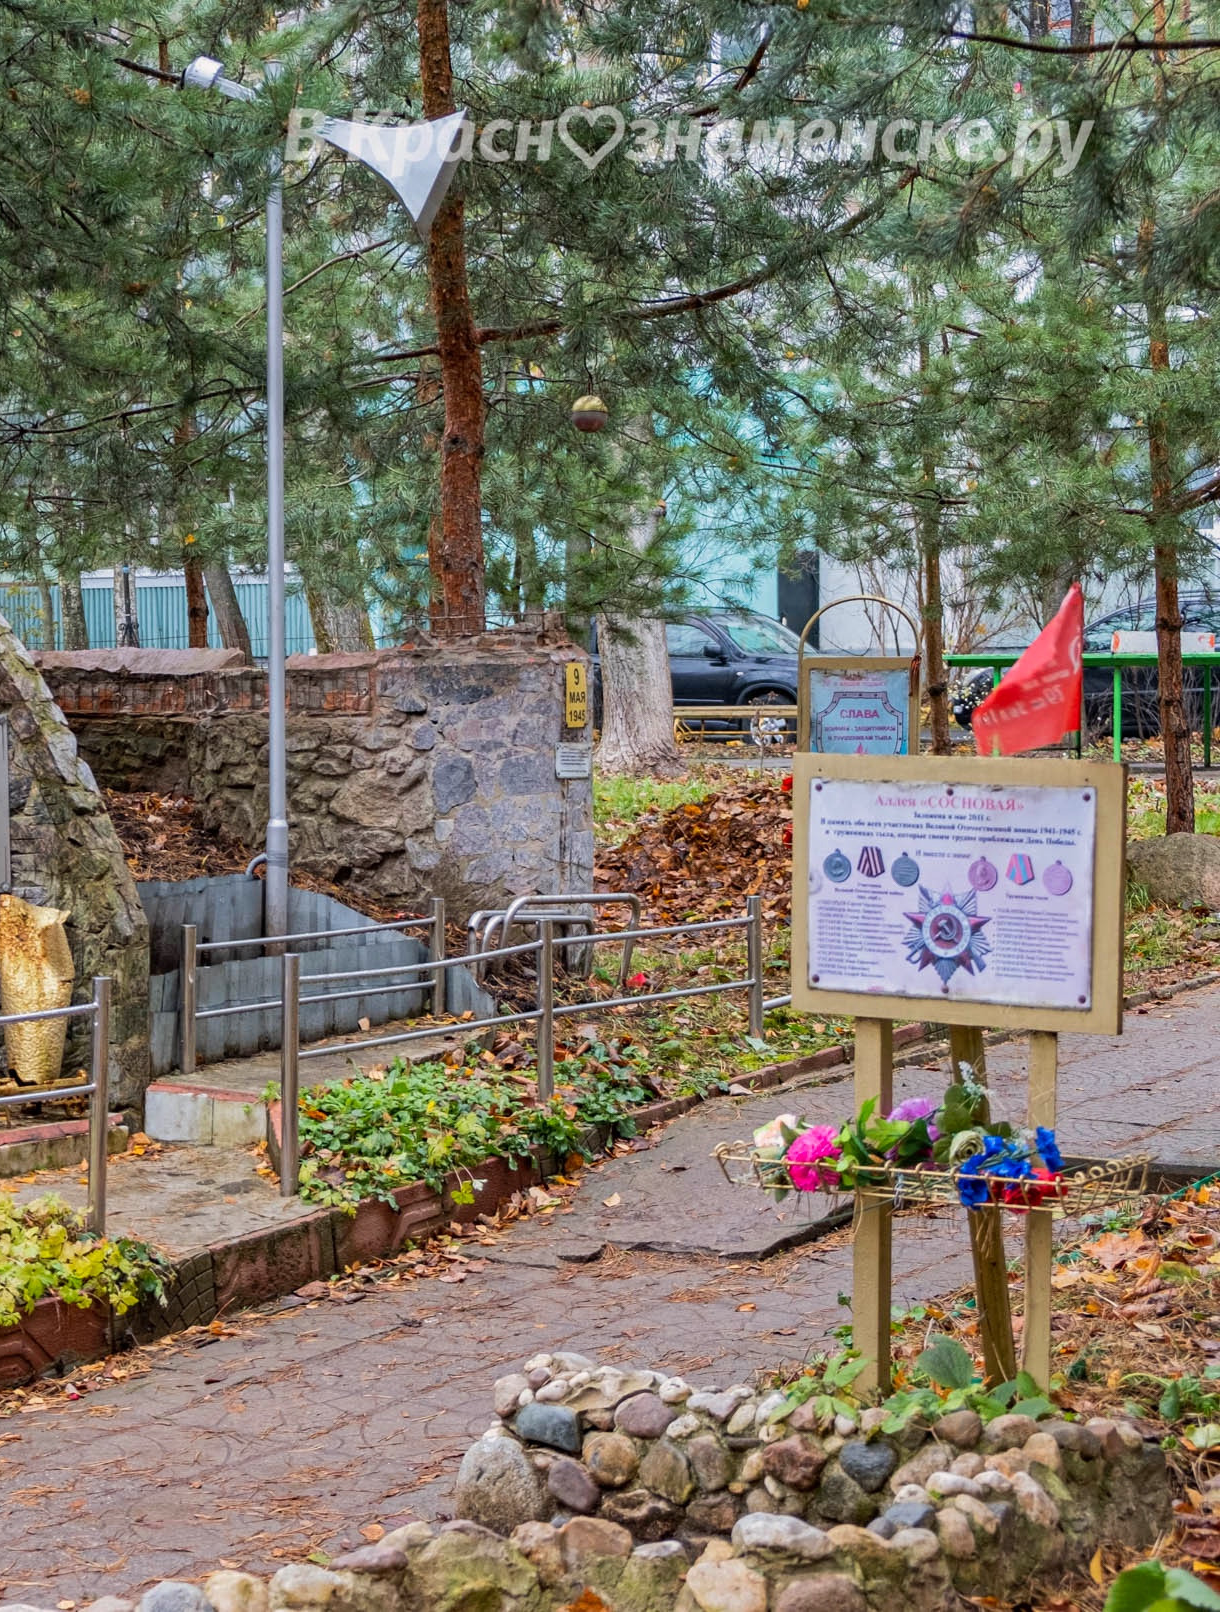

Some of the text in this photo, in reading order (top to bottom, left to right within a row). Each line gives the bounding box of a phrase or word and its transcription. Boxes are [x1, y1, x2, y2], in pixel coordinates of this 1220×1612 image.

[573, 668, 580, 685] 9
[569, 691, 586, 703] МАЯ
[569, 710, 586, 722] 1945
[840, 709, 880, 718] СЛАВА
[875, 795, 1024, 811] Аллея «СОСНОВАЯ»
